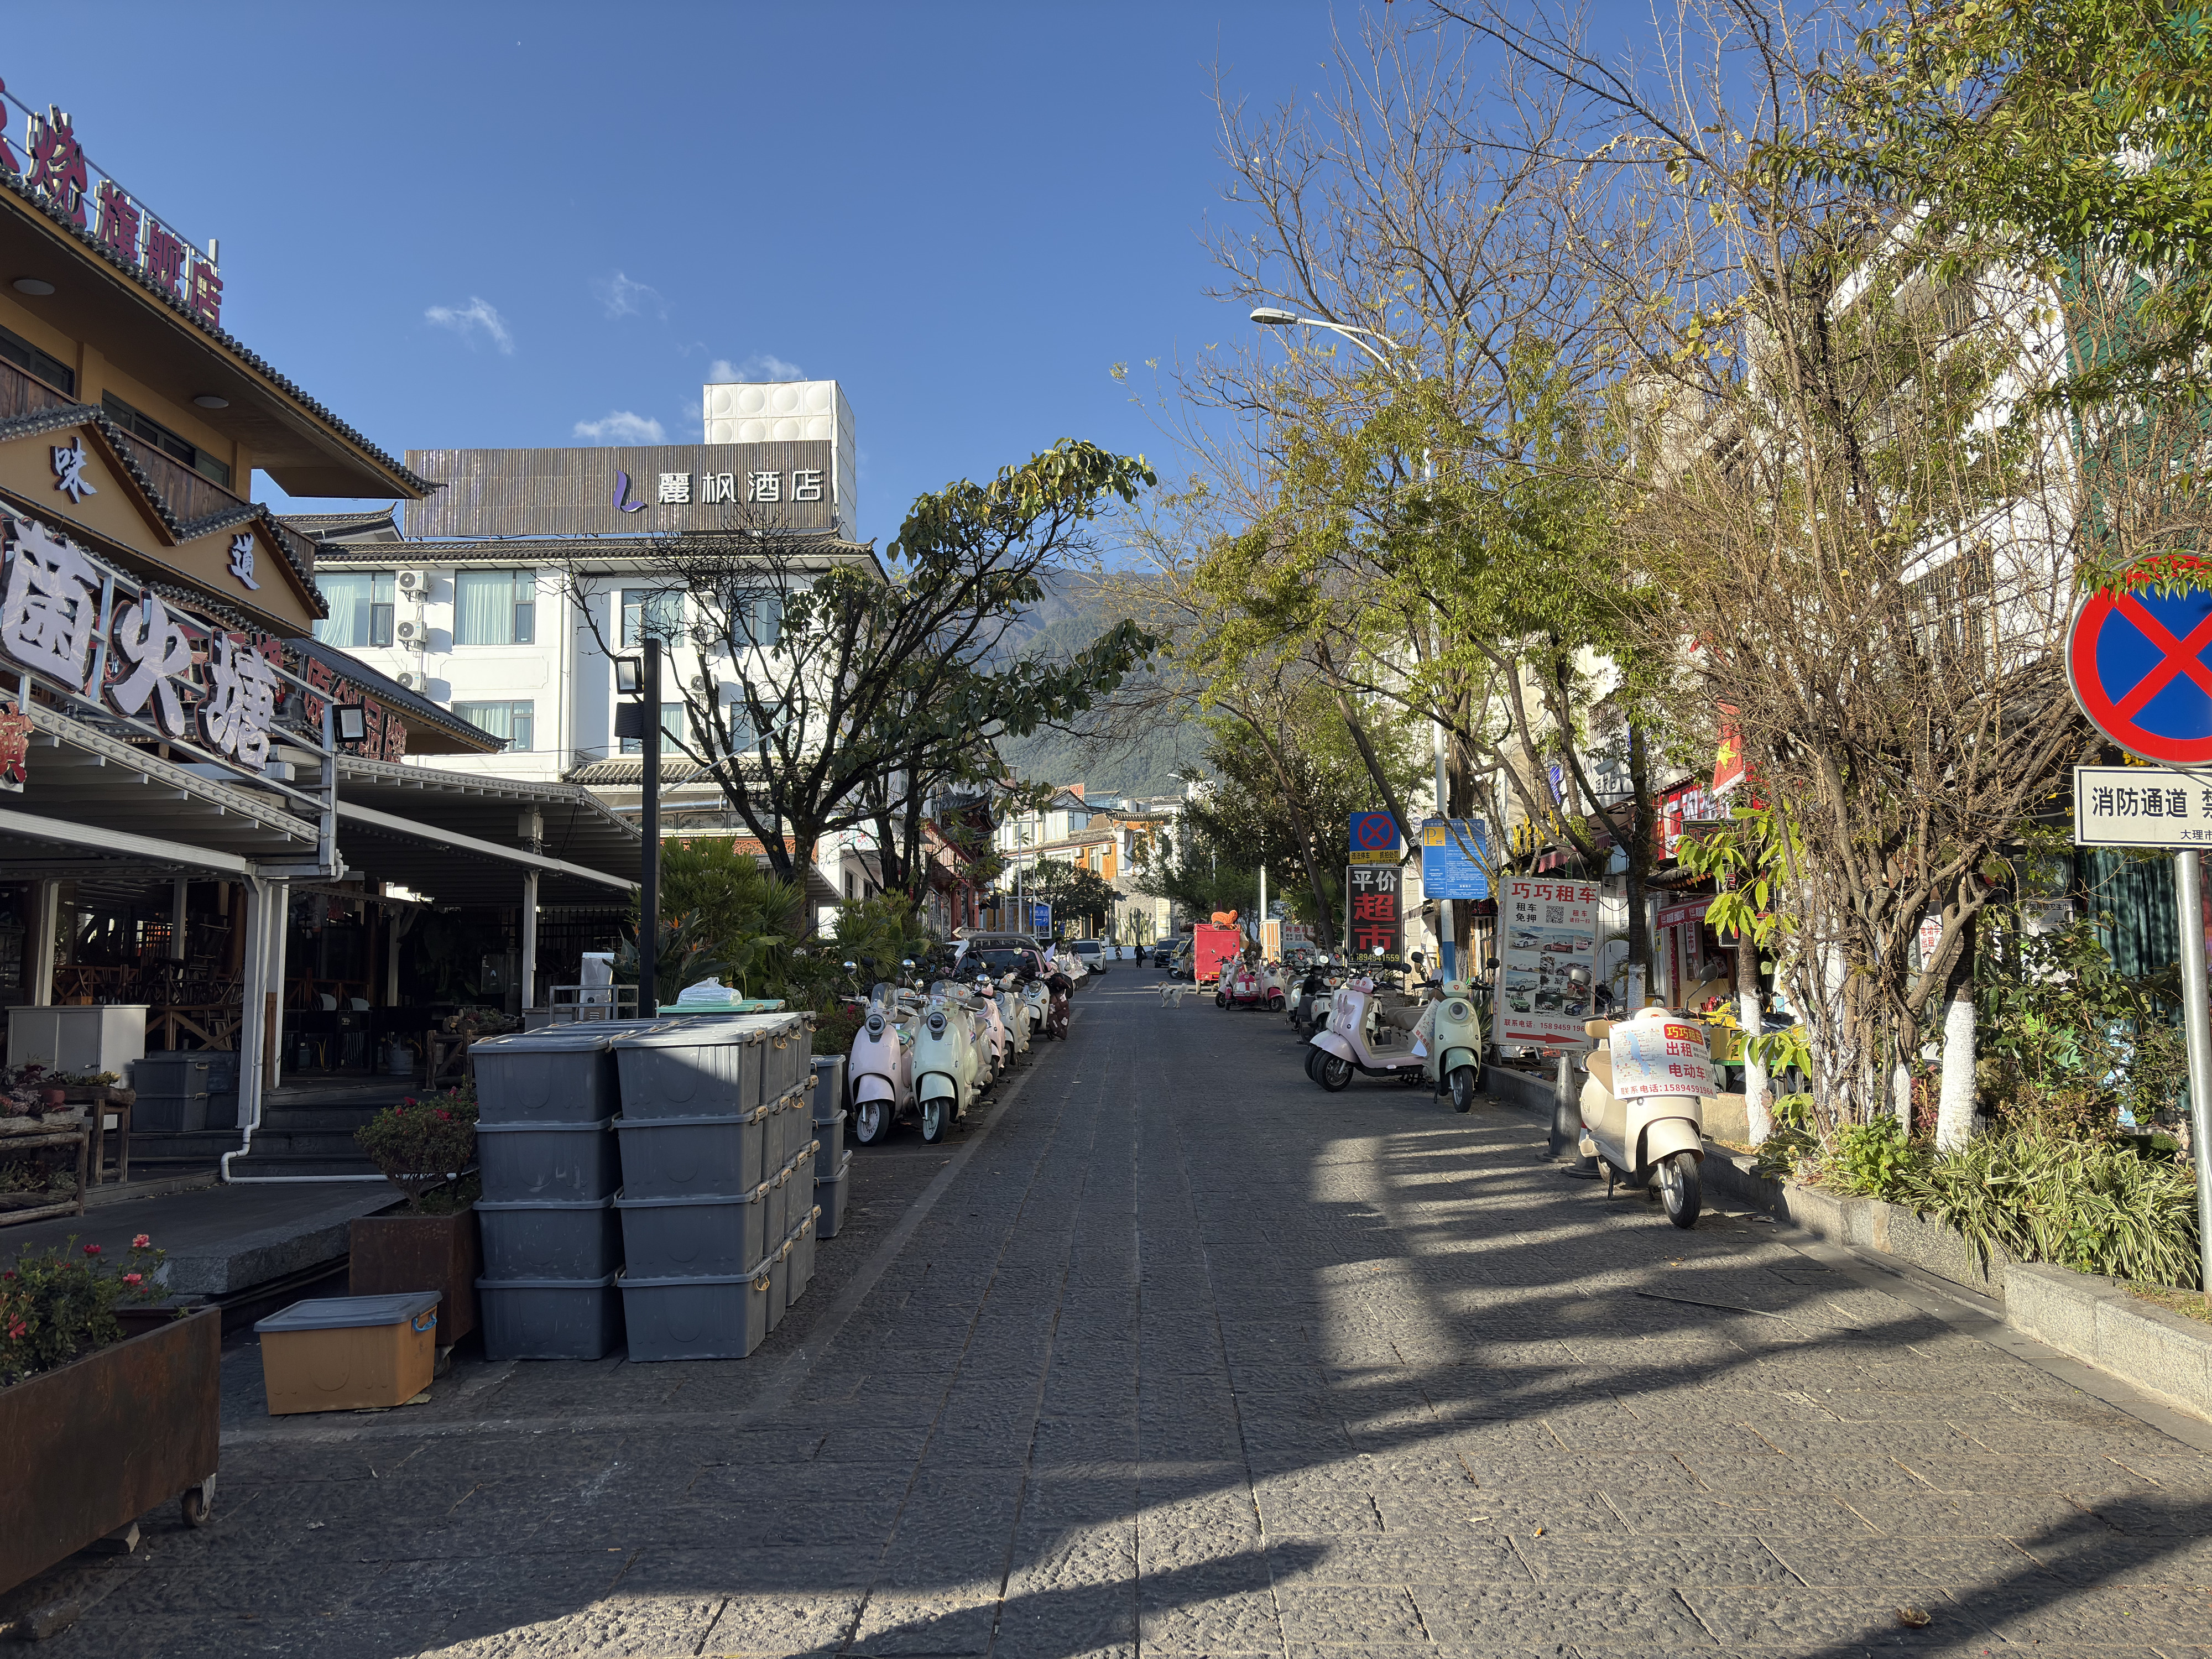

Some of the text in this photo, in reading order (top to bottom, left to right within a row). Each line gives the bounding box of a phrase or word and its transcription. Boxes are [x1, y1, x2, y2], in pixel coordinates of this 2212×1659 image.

[0, 74, 223, 328] 烧旗舰店
[50, 436, 96, 504] 味
[658, 468, 822, 504] 麗枫酒店
[228, 532, 260, 591] 道
[2091, 786, 2189, 818] 消防通道
[1426, 828, 1437, 845] P
[2180, 829, 2212, 841] 大理市
[1351, 851, 1399, 860] 违法停车 抓拍处罚
[1352, 870, 1397, 892] 平价
[1511, 882, 1597, 904] 巧巧租车
[1516, 902, 1537, 912] 租车
[1354, 893, 1396, 951] 超市
[1515, 912, 1537, 923] 免押
[1921, 937, 1935, 948] 出租
[1666, 1026, 1703, 1044] 巧巧租车
[1666, 1041, 1693, 1057] 出租
[1668, 1062, 1706, 1080] 电动车
